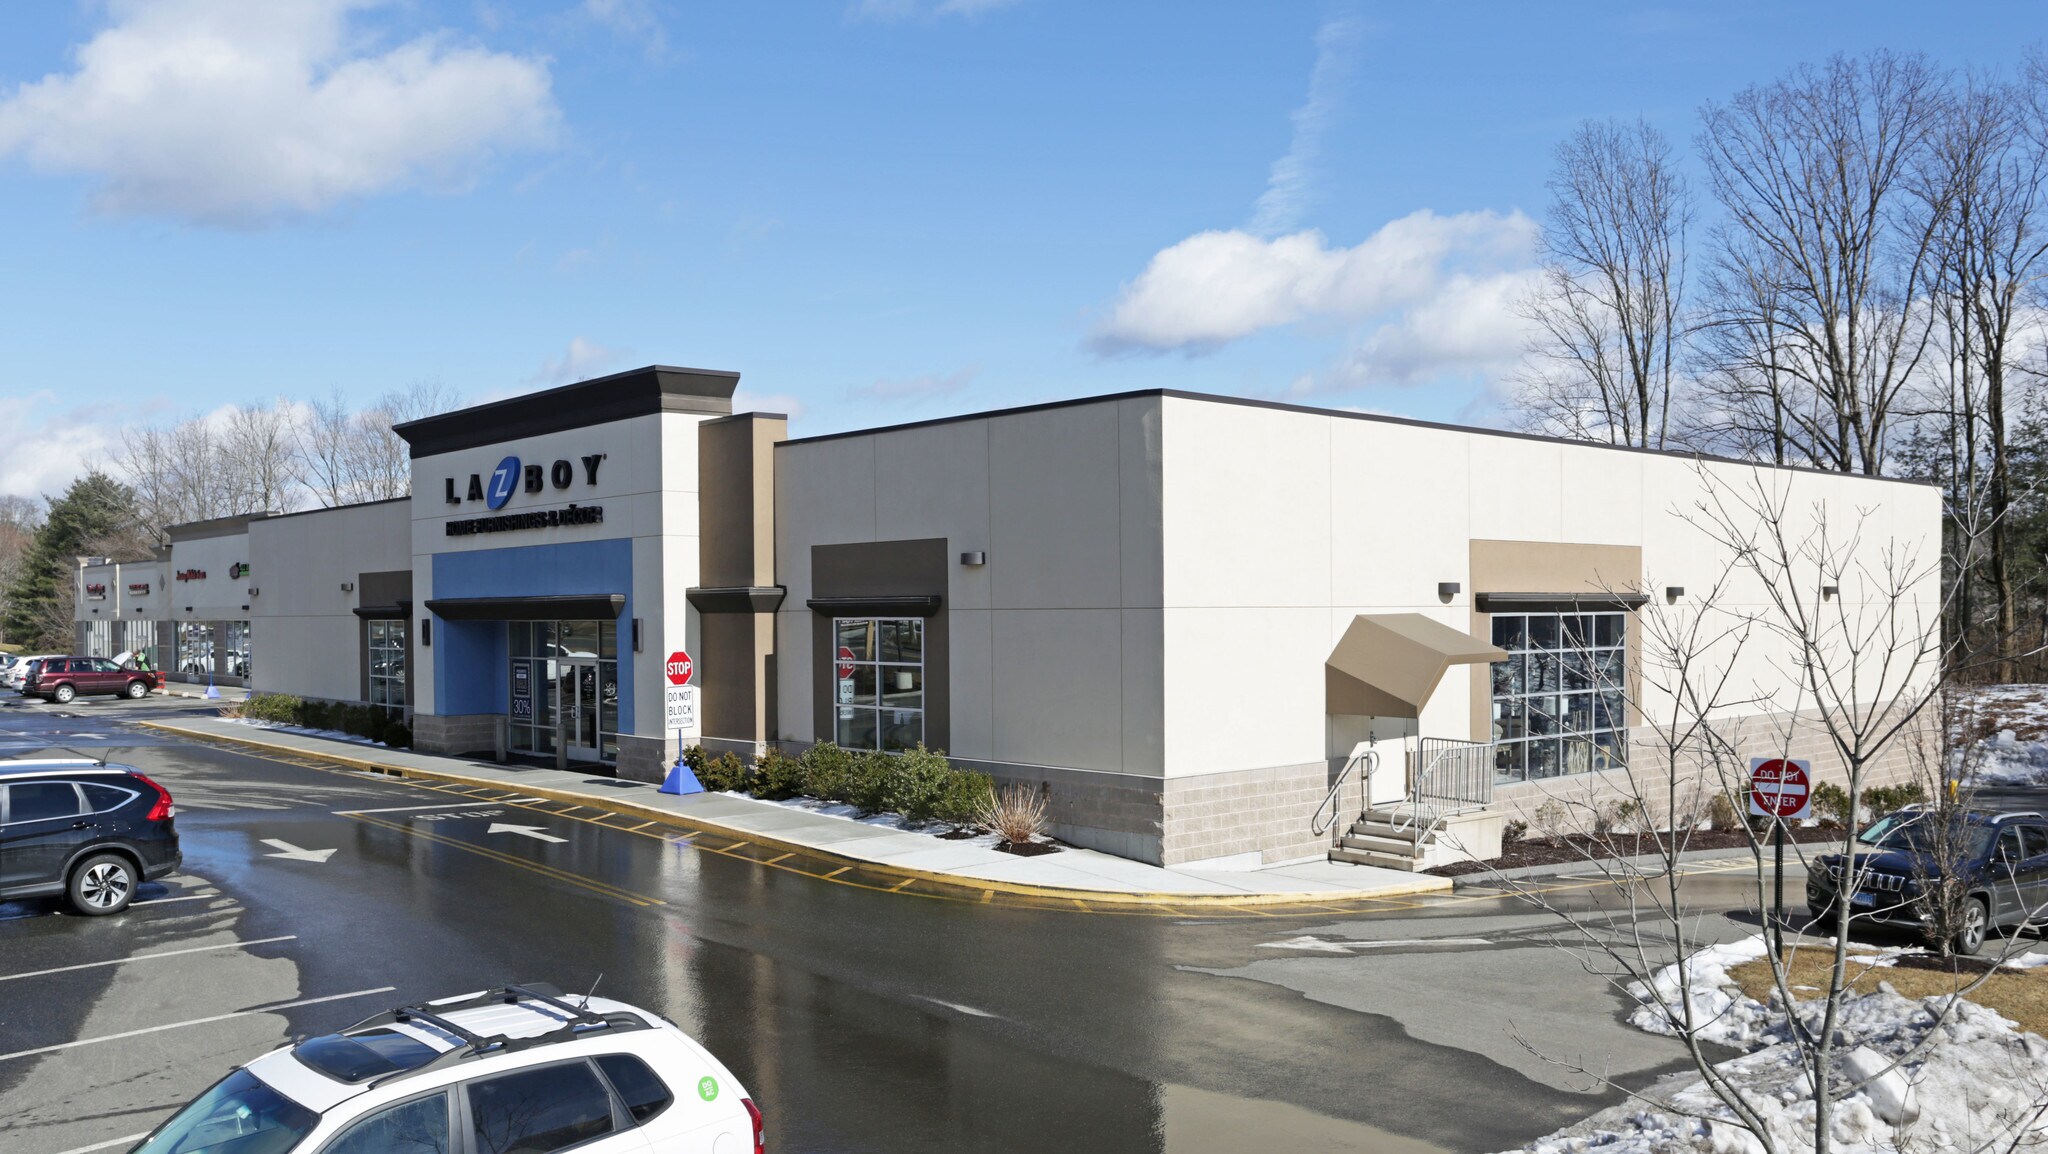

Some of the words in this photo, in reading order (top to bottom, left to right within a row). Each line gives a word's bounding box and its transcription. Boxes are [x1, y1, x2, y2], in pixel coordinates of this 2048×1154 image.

[445, 519, 473, 536] HOME
[667, 661, 691, 676] STOP
[668, 692, 678, 703] DO
[678, 690, 691, 701] NOT
[513, 699, 531, 714] 30%
[668, 704, 692, 716] BLOCK
[668, 716, 693, 726] INTERSECTION
[1760, 769, 1775, 780] DO
[1779, 770, 1799, 782] NOT
[1763, 795, 1797, 807] ENTER
[702, 1080, 712, 1089] DO
